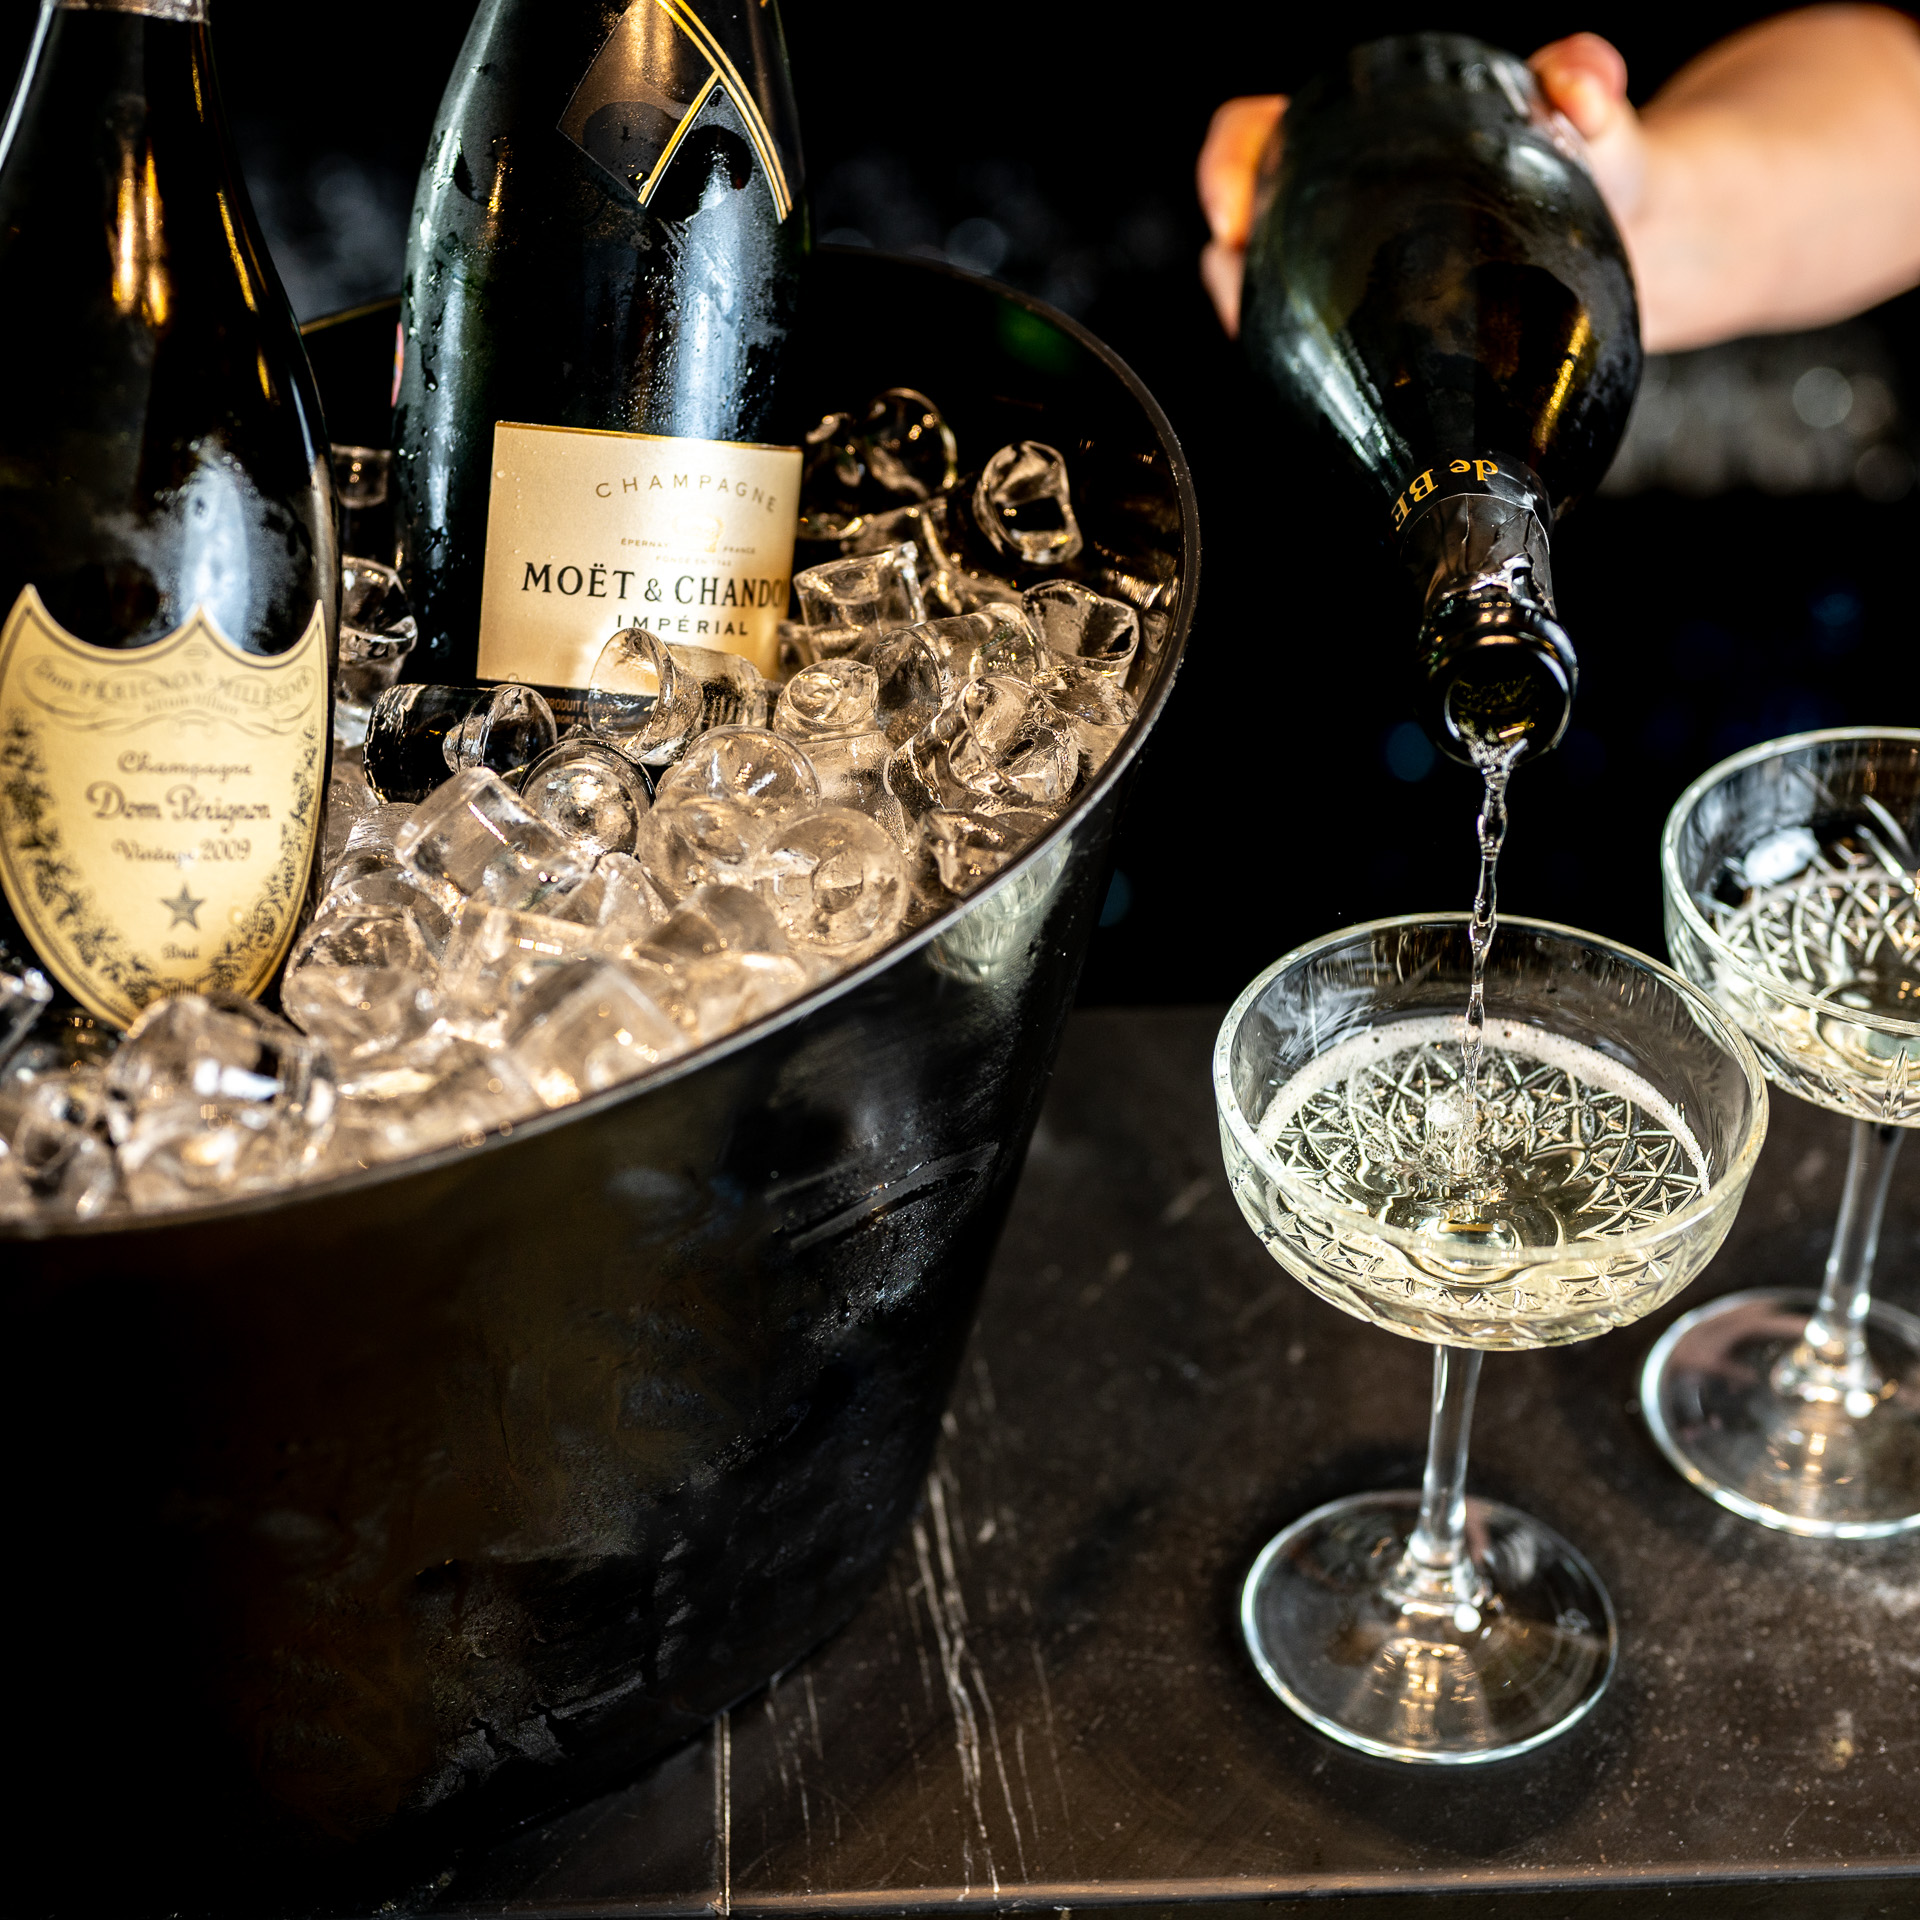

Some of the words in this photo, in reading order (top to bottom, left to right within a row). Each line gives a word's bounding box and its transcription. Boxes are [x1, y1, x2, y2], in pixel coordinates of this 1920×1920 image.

[1449, 459, 1499, 482] de
[595, 474, 777, 512] CHAMPAGNE
[521, 562, 635, 599] MOËT
[644, 578, 662, 602] &
[617, 615, 749, 636] IMPÉRIAL
[117, 750, 252, 783] Champagne
[86, 781, 161, 821] Dom
[166, 784, 271, 833] Pérignon
[112, 839, 195, 868] Vintage
[199, 838, 251, 861] 2009
